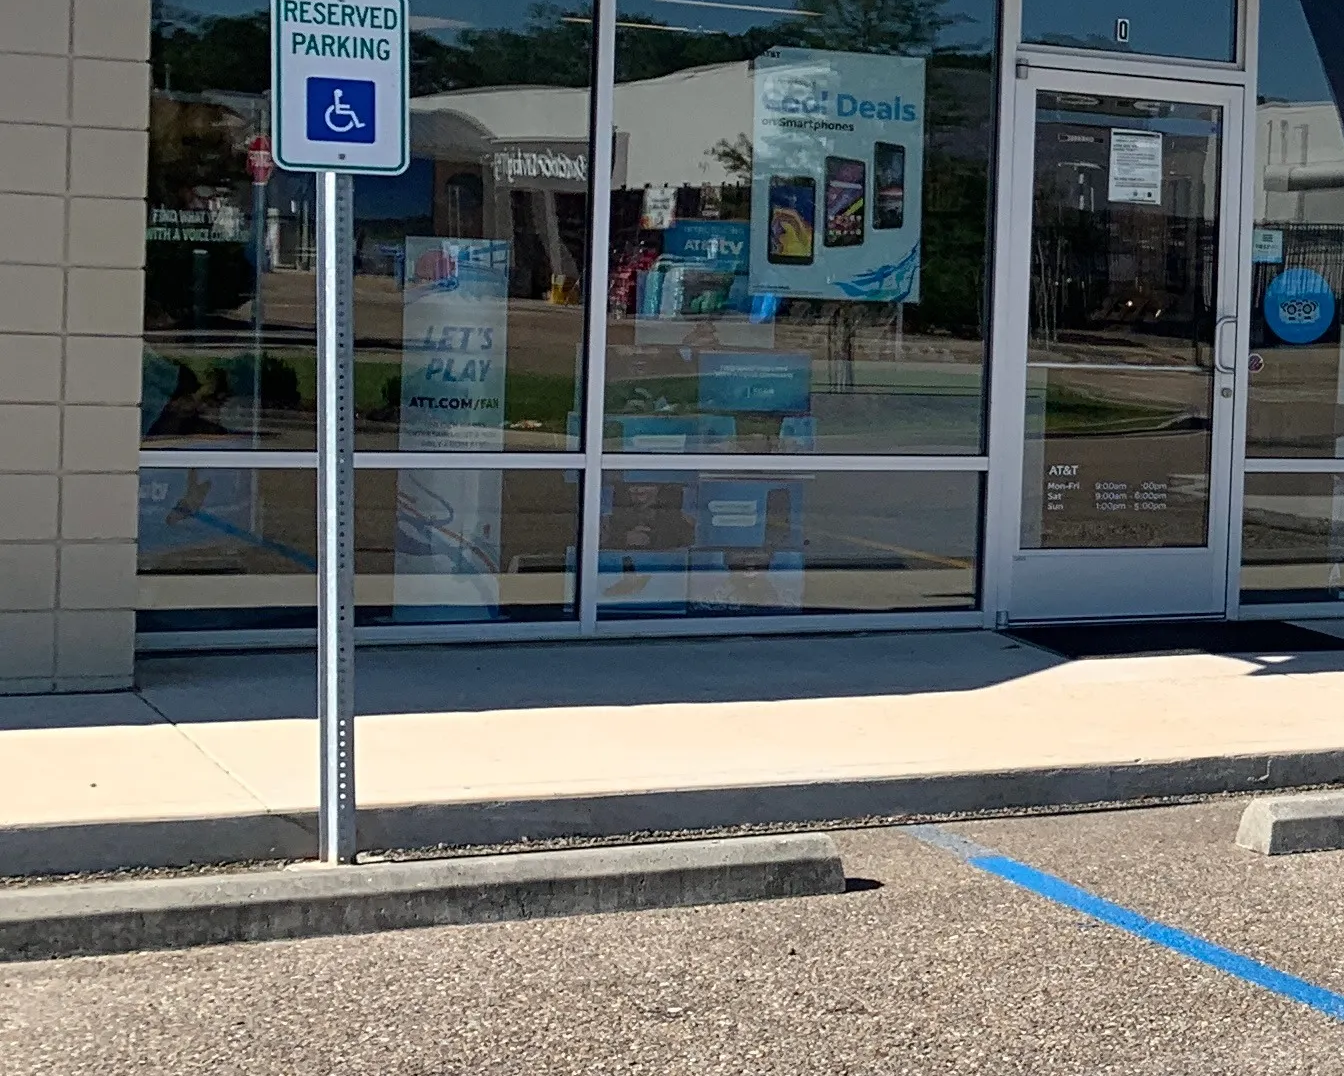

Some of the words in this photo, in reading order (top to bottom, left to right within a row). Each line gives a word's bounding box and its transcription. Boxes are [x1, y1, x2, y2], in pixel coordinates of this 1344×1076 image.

[282, 0, 398, 31] RESERVED
[291, 31, 391, 63] PARKING
[836, 93, 917, 122] Deals
[779, 117, 855, 132] Smartphones
[424, 325, 494, 351] LET'S
[425, 357, 492, 382] PLAY
[409, 396, 499, 411] ATT.COM/FAN
[1048, 465, 1079, 476] AT&T
[1047, 482, 1080, 490] Mon-Fri
[1047, 492, 1062, 500] Sat
[1047, 502, 1064, 510] Sun
[1095, 502, 1126, 511] 1:00pm
